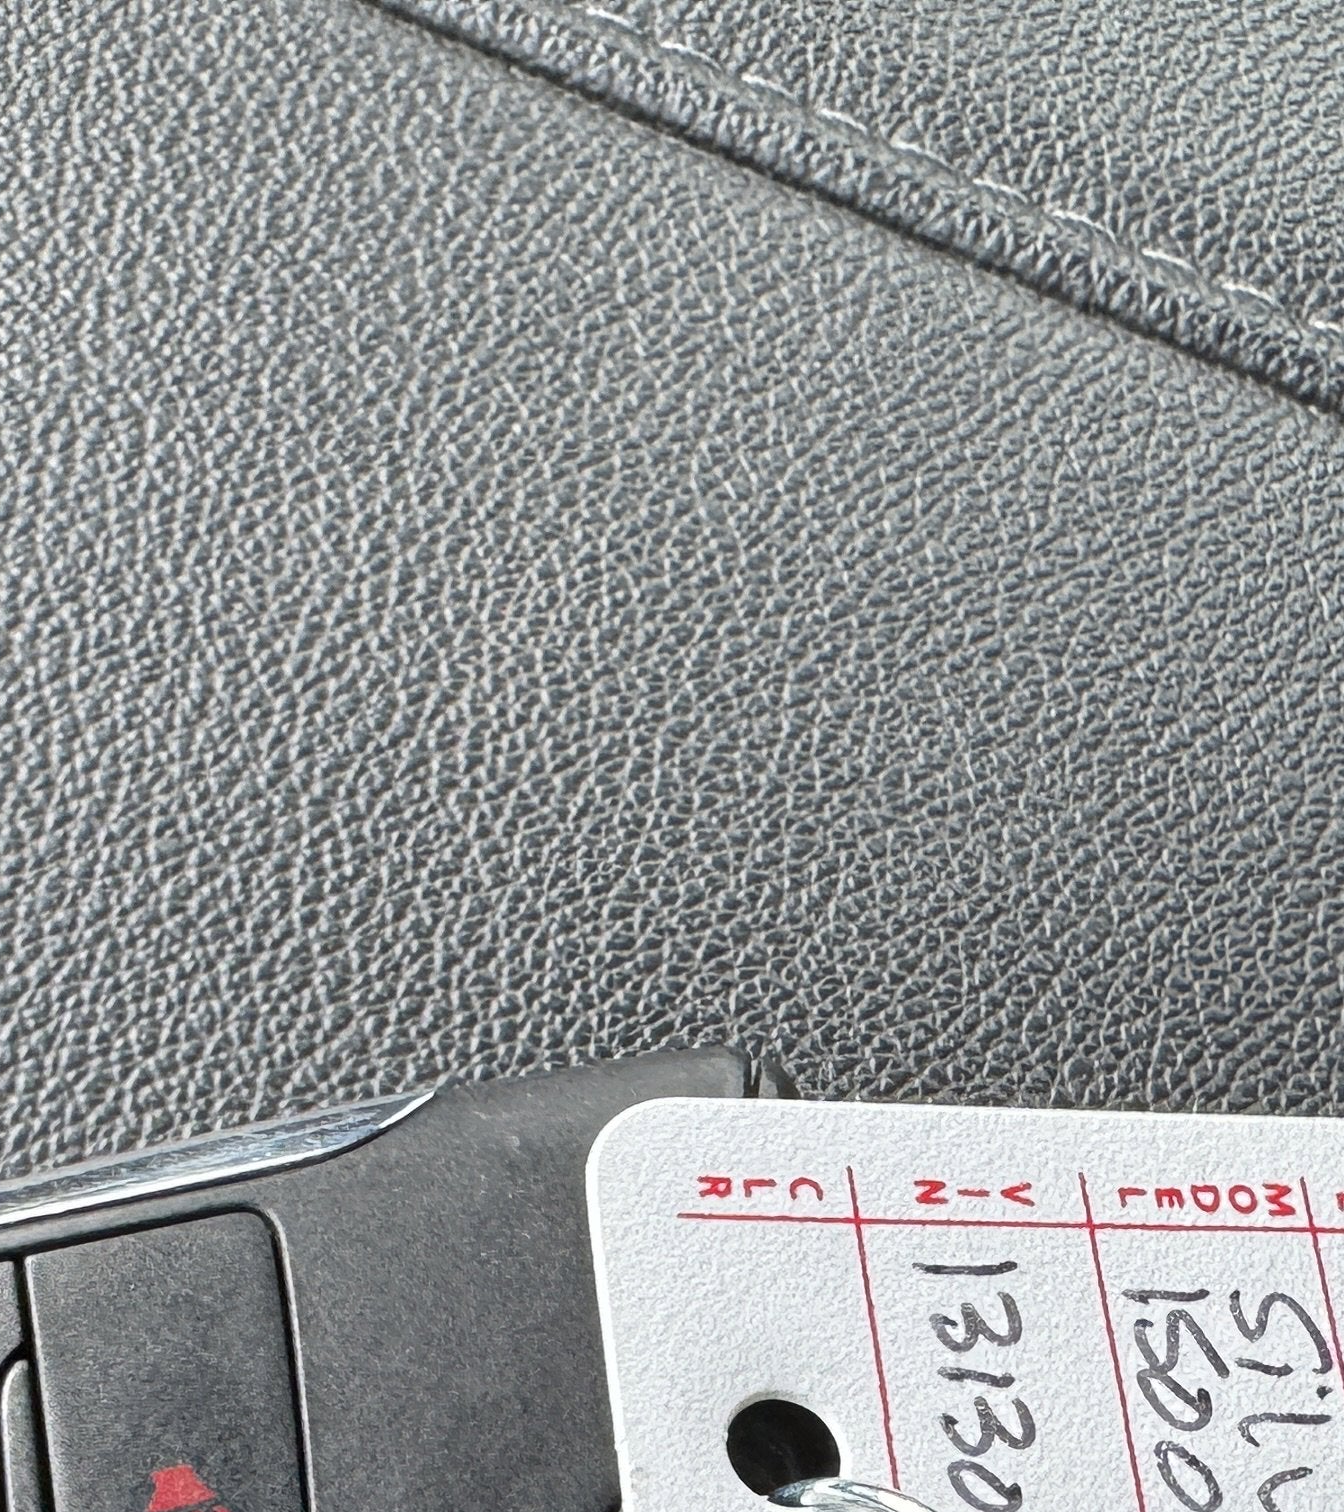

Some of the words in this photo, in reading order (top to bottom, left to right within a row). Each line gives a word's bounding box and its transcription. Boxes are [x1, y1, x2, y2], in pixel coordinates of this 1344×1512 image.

[697, 1174, 825, 1202] CLR
[913, 1178, 1035, 1207] VIN
[1116, 1182, 1297, 1218] MODEL
